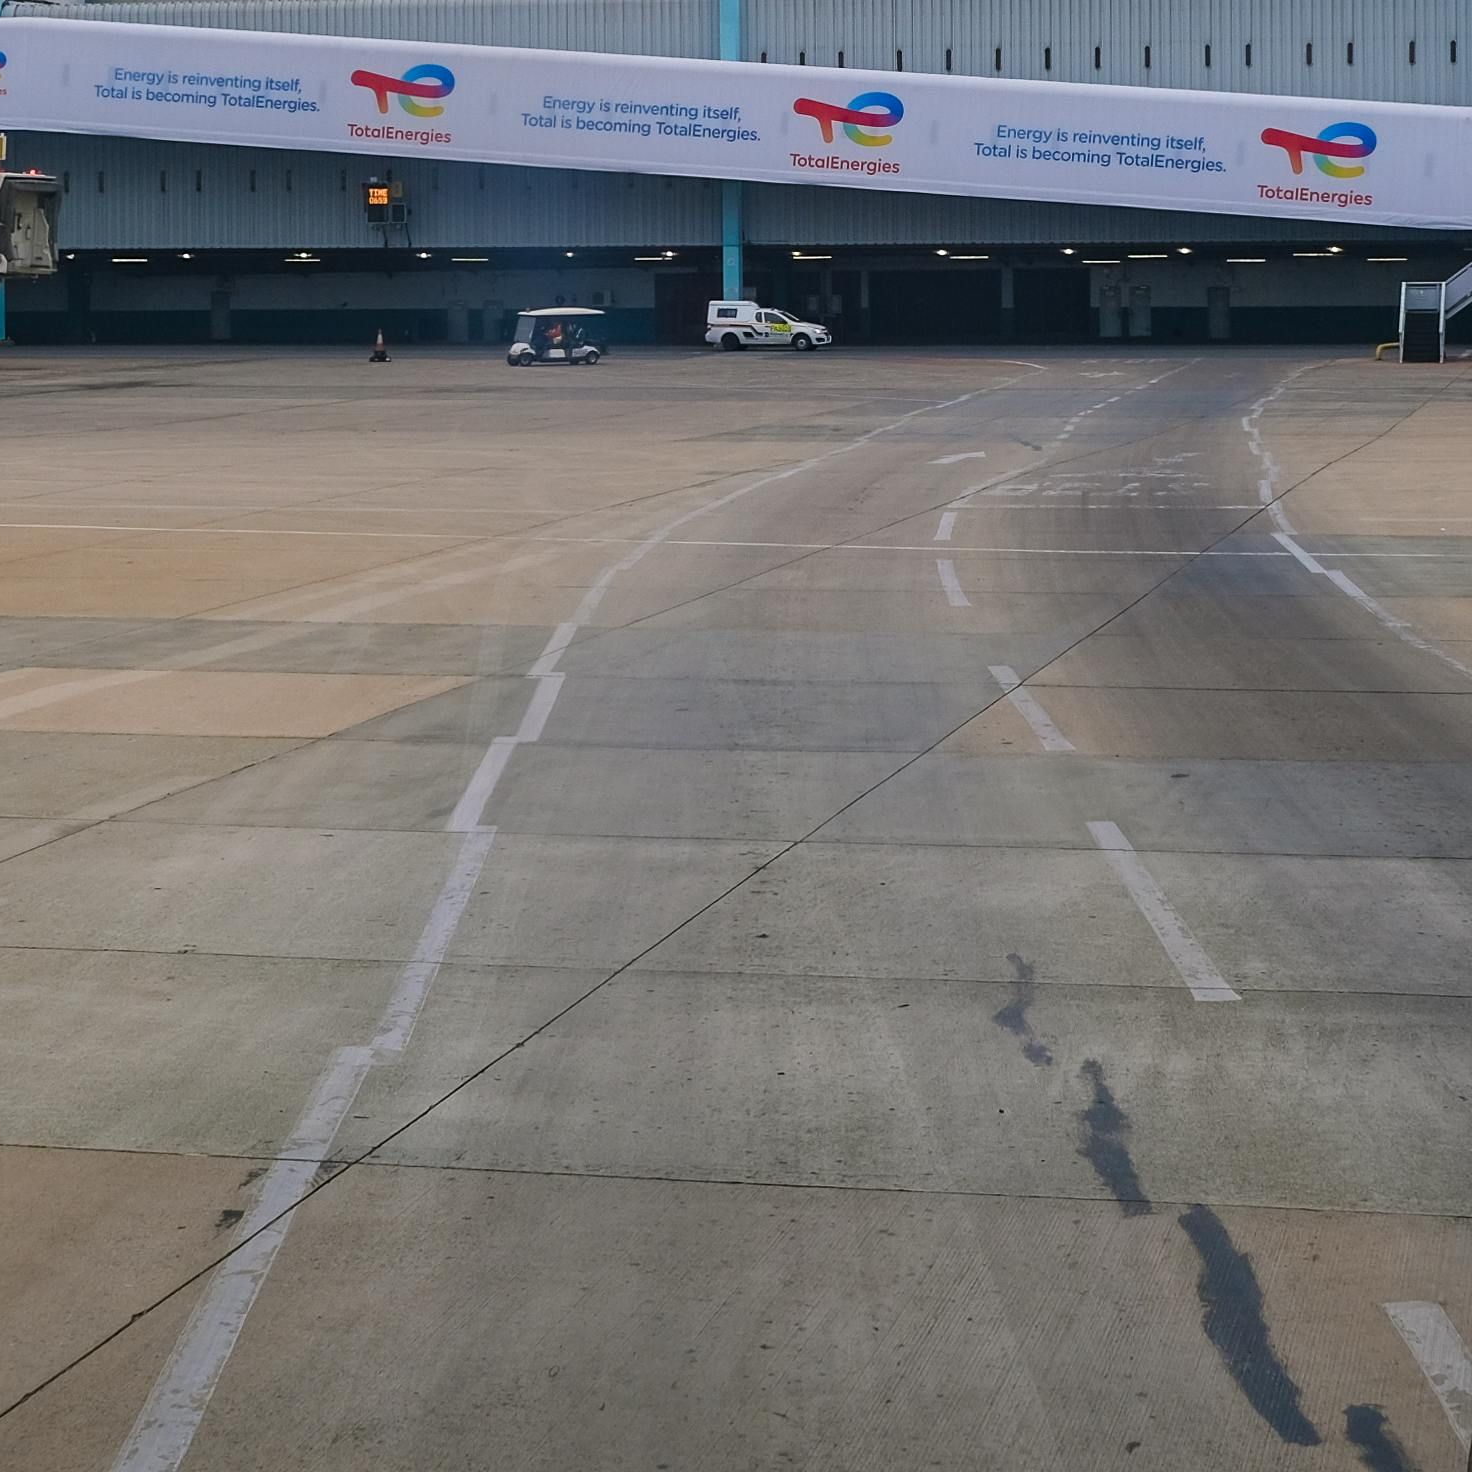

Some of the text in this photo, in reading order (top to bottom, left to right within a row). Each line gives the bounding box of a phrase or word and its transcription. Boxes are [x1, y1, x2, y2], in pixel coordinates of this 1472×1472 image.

[113, 68, 301, 94] Energy is reinventing itself,
[93, 85, 320, 113] Total is becoming TotalEnergies.
[543, 96, 740, 122] Energy is reinventing itself,
[347, 124, 452, 145] TotalEnergies
[521, 114, 760, 142] Total is becoming TotalEnergies.
[996, 125, 1205, 153] Energy is reinventing itself,
[789, 154, 901, 175] TotalEnergies
[973, 143, 1226, 173] Total is becoming TotalEnergies.
[1256, 185, 1373, 207] TotalEnergies
